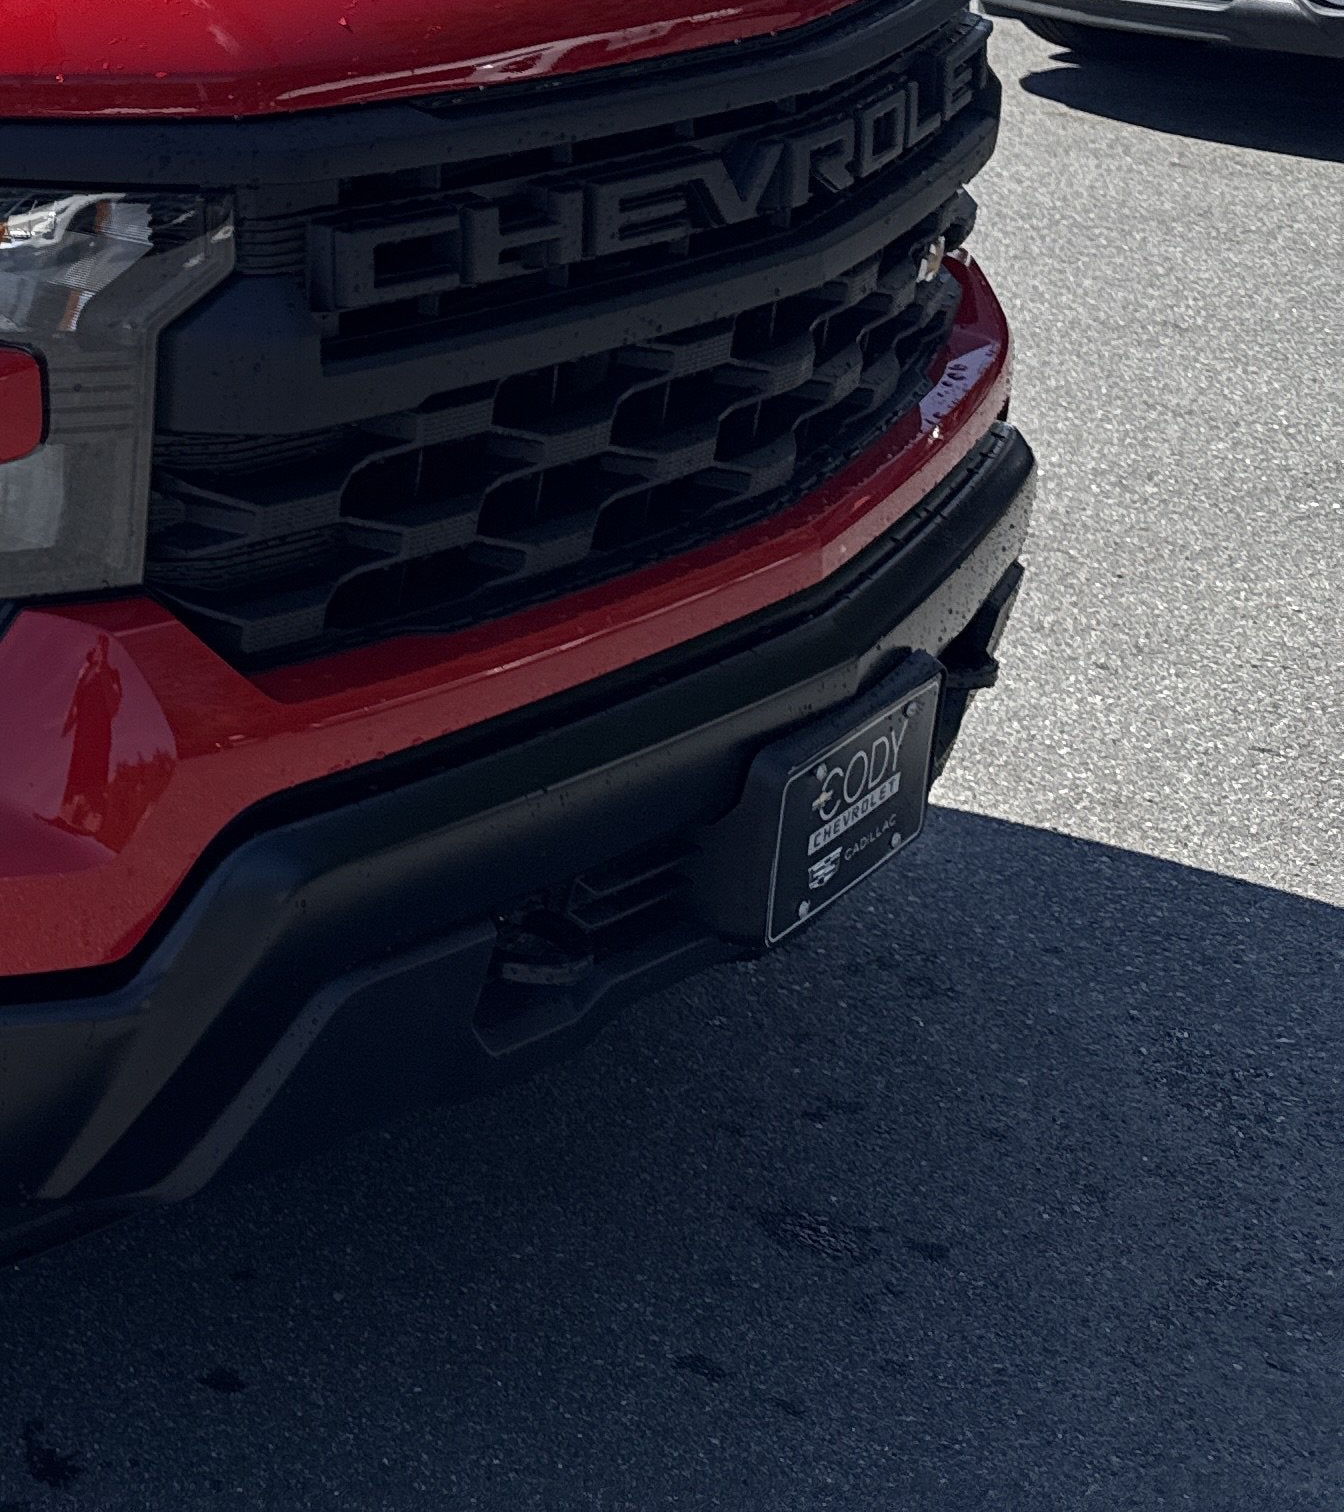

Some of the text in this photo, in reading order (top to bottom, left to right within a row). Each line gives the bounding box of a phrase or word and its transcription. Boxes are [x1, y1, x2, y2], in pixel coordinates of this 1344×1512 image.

[816, 718, 909, 821] CODY
[812, 777, 898, 849] CHEVROLET
[843, 813, 897, 861] CADILLAC
